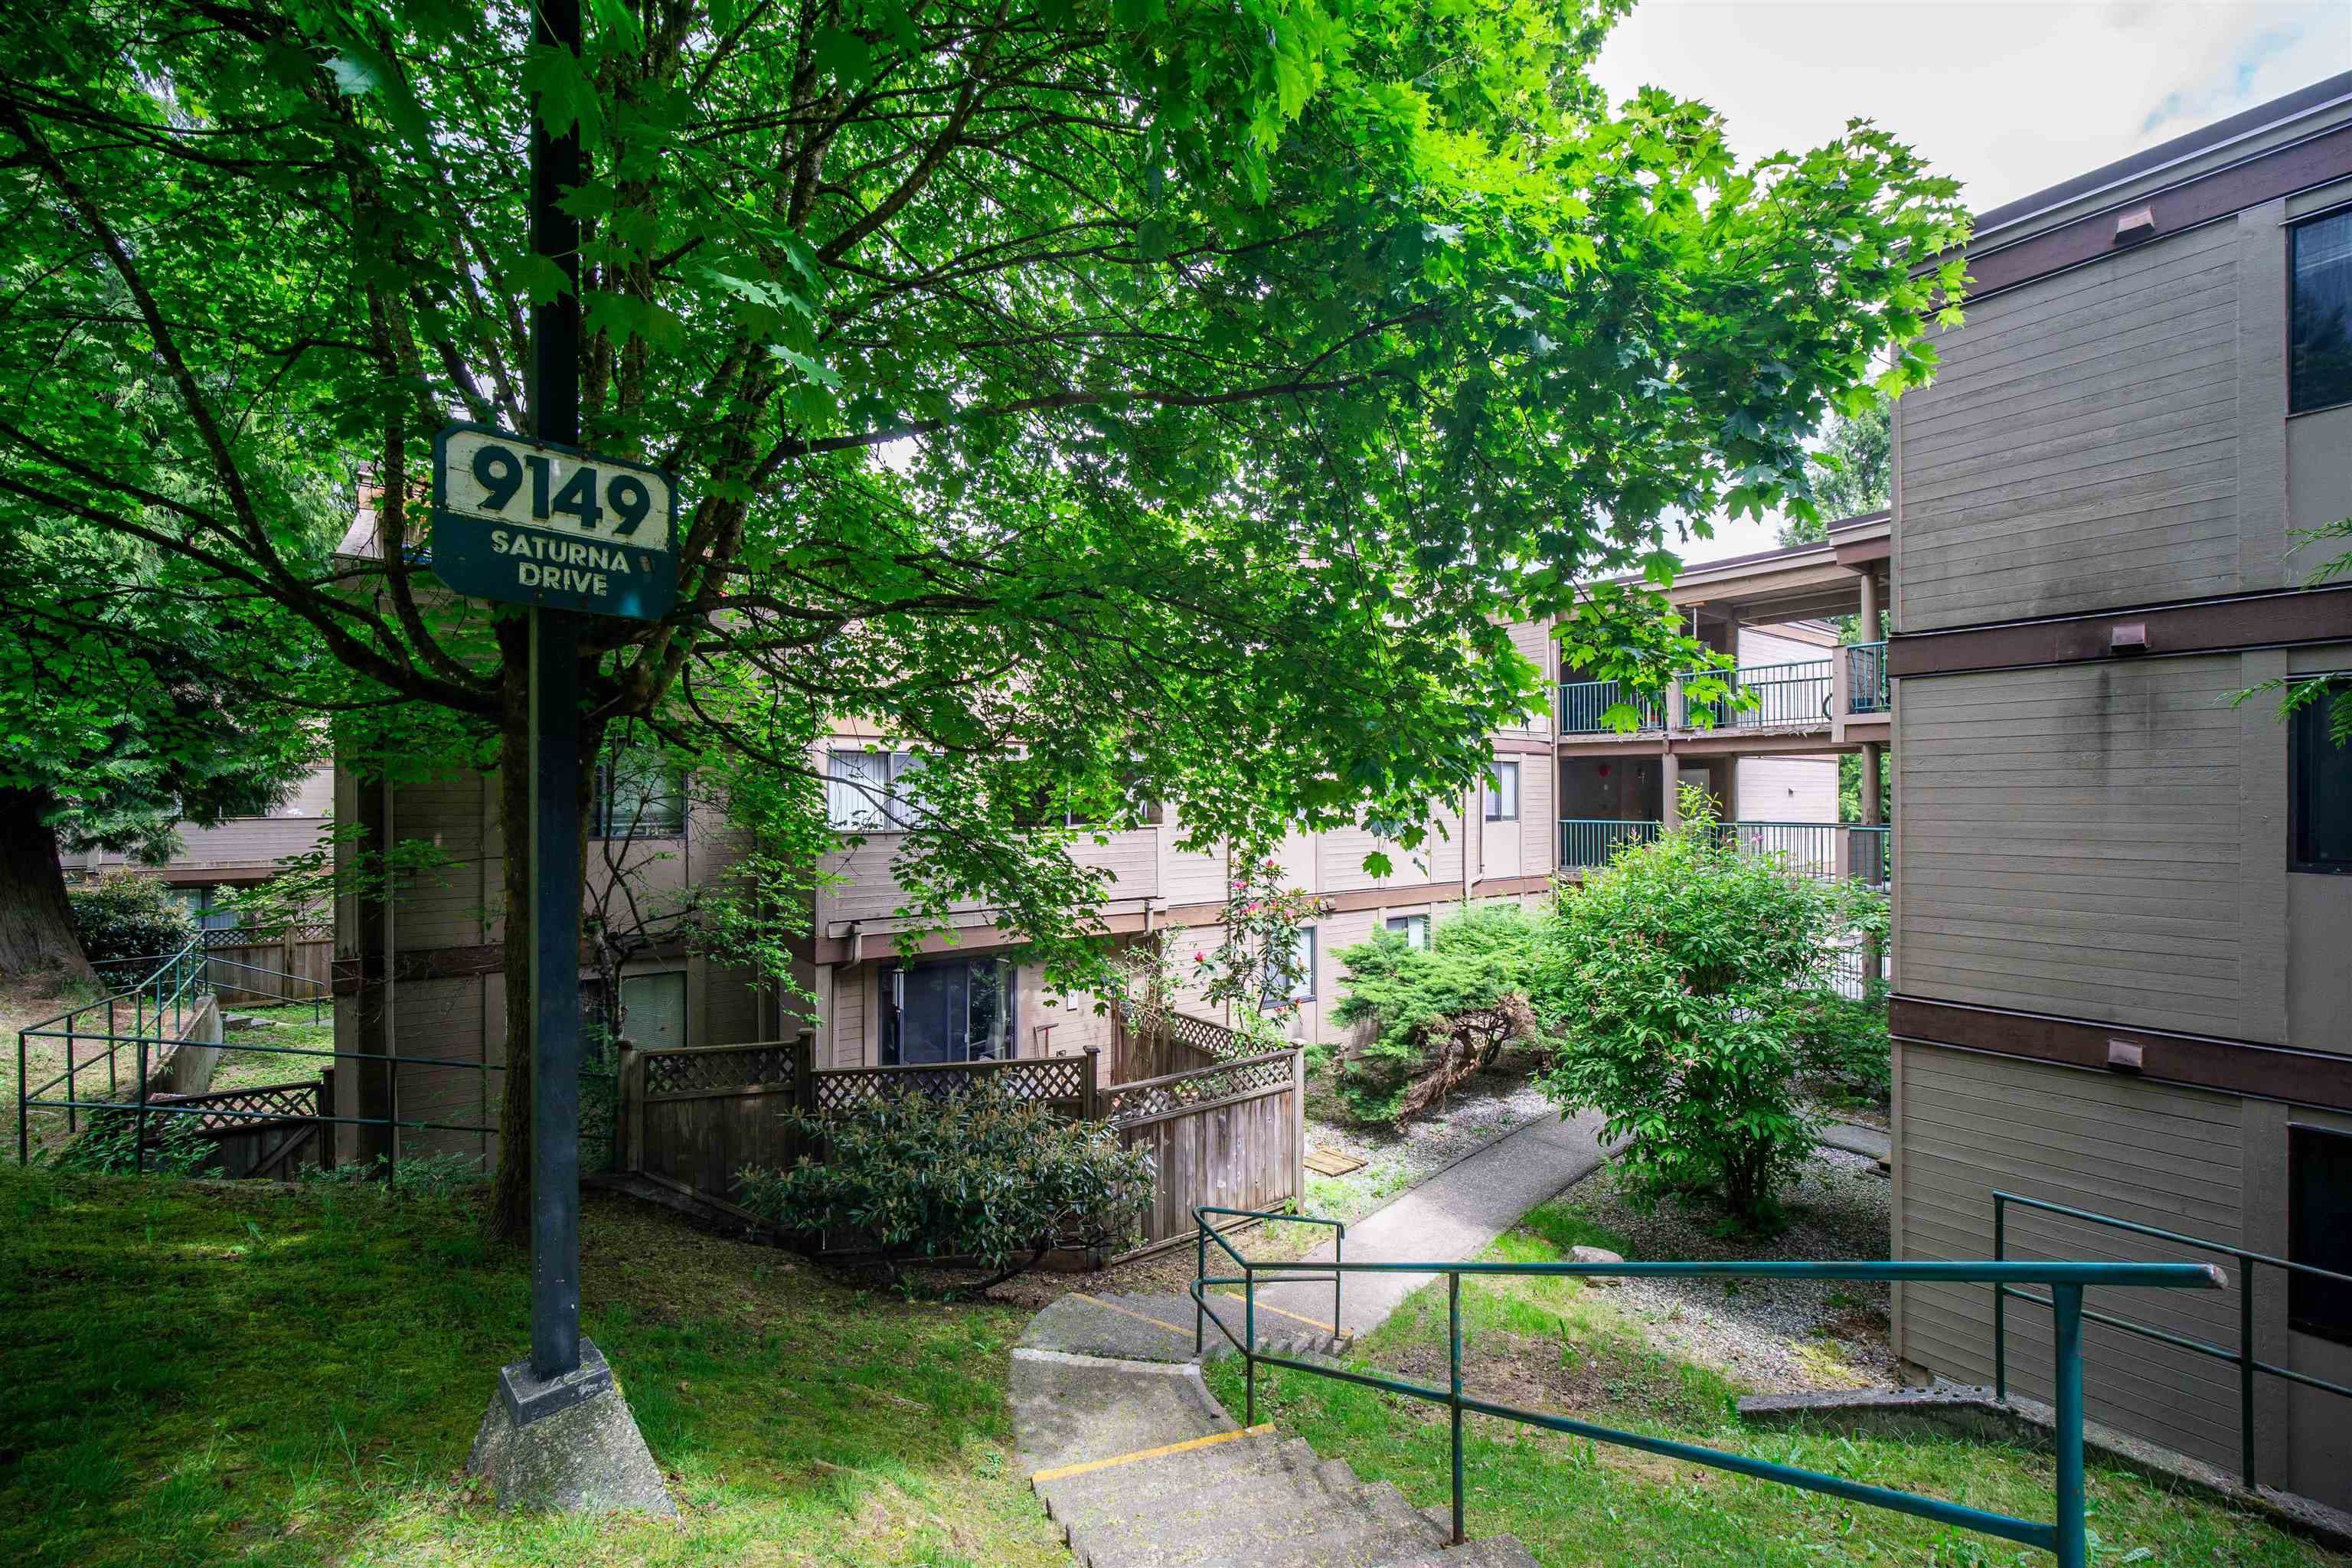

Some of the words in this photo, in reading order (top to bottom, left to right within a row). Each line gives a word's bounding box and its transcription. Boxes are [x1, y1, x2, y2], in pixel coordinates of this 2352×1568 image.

[473, 446, 650, 536] 9149
[491, 531, 630, 574] SATURNA
[518, 562, 607, 596] DRIVE
